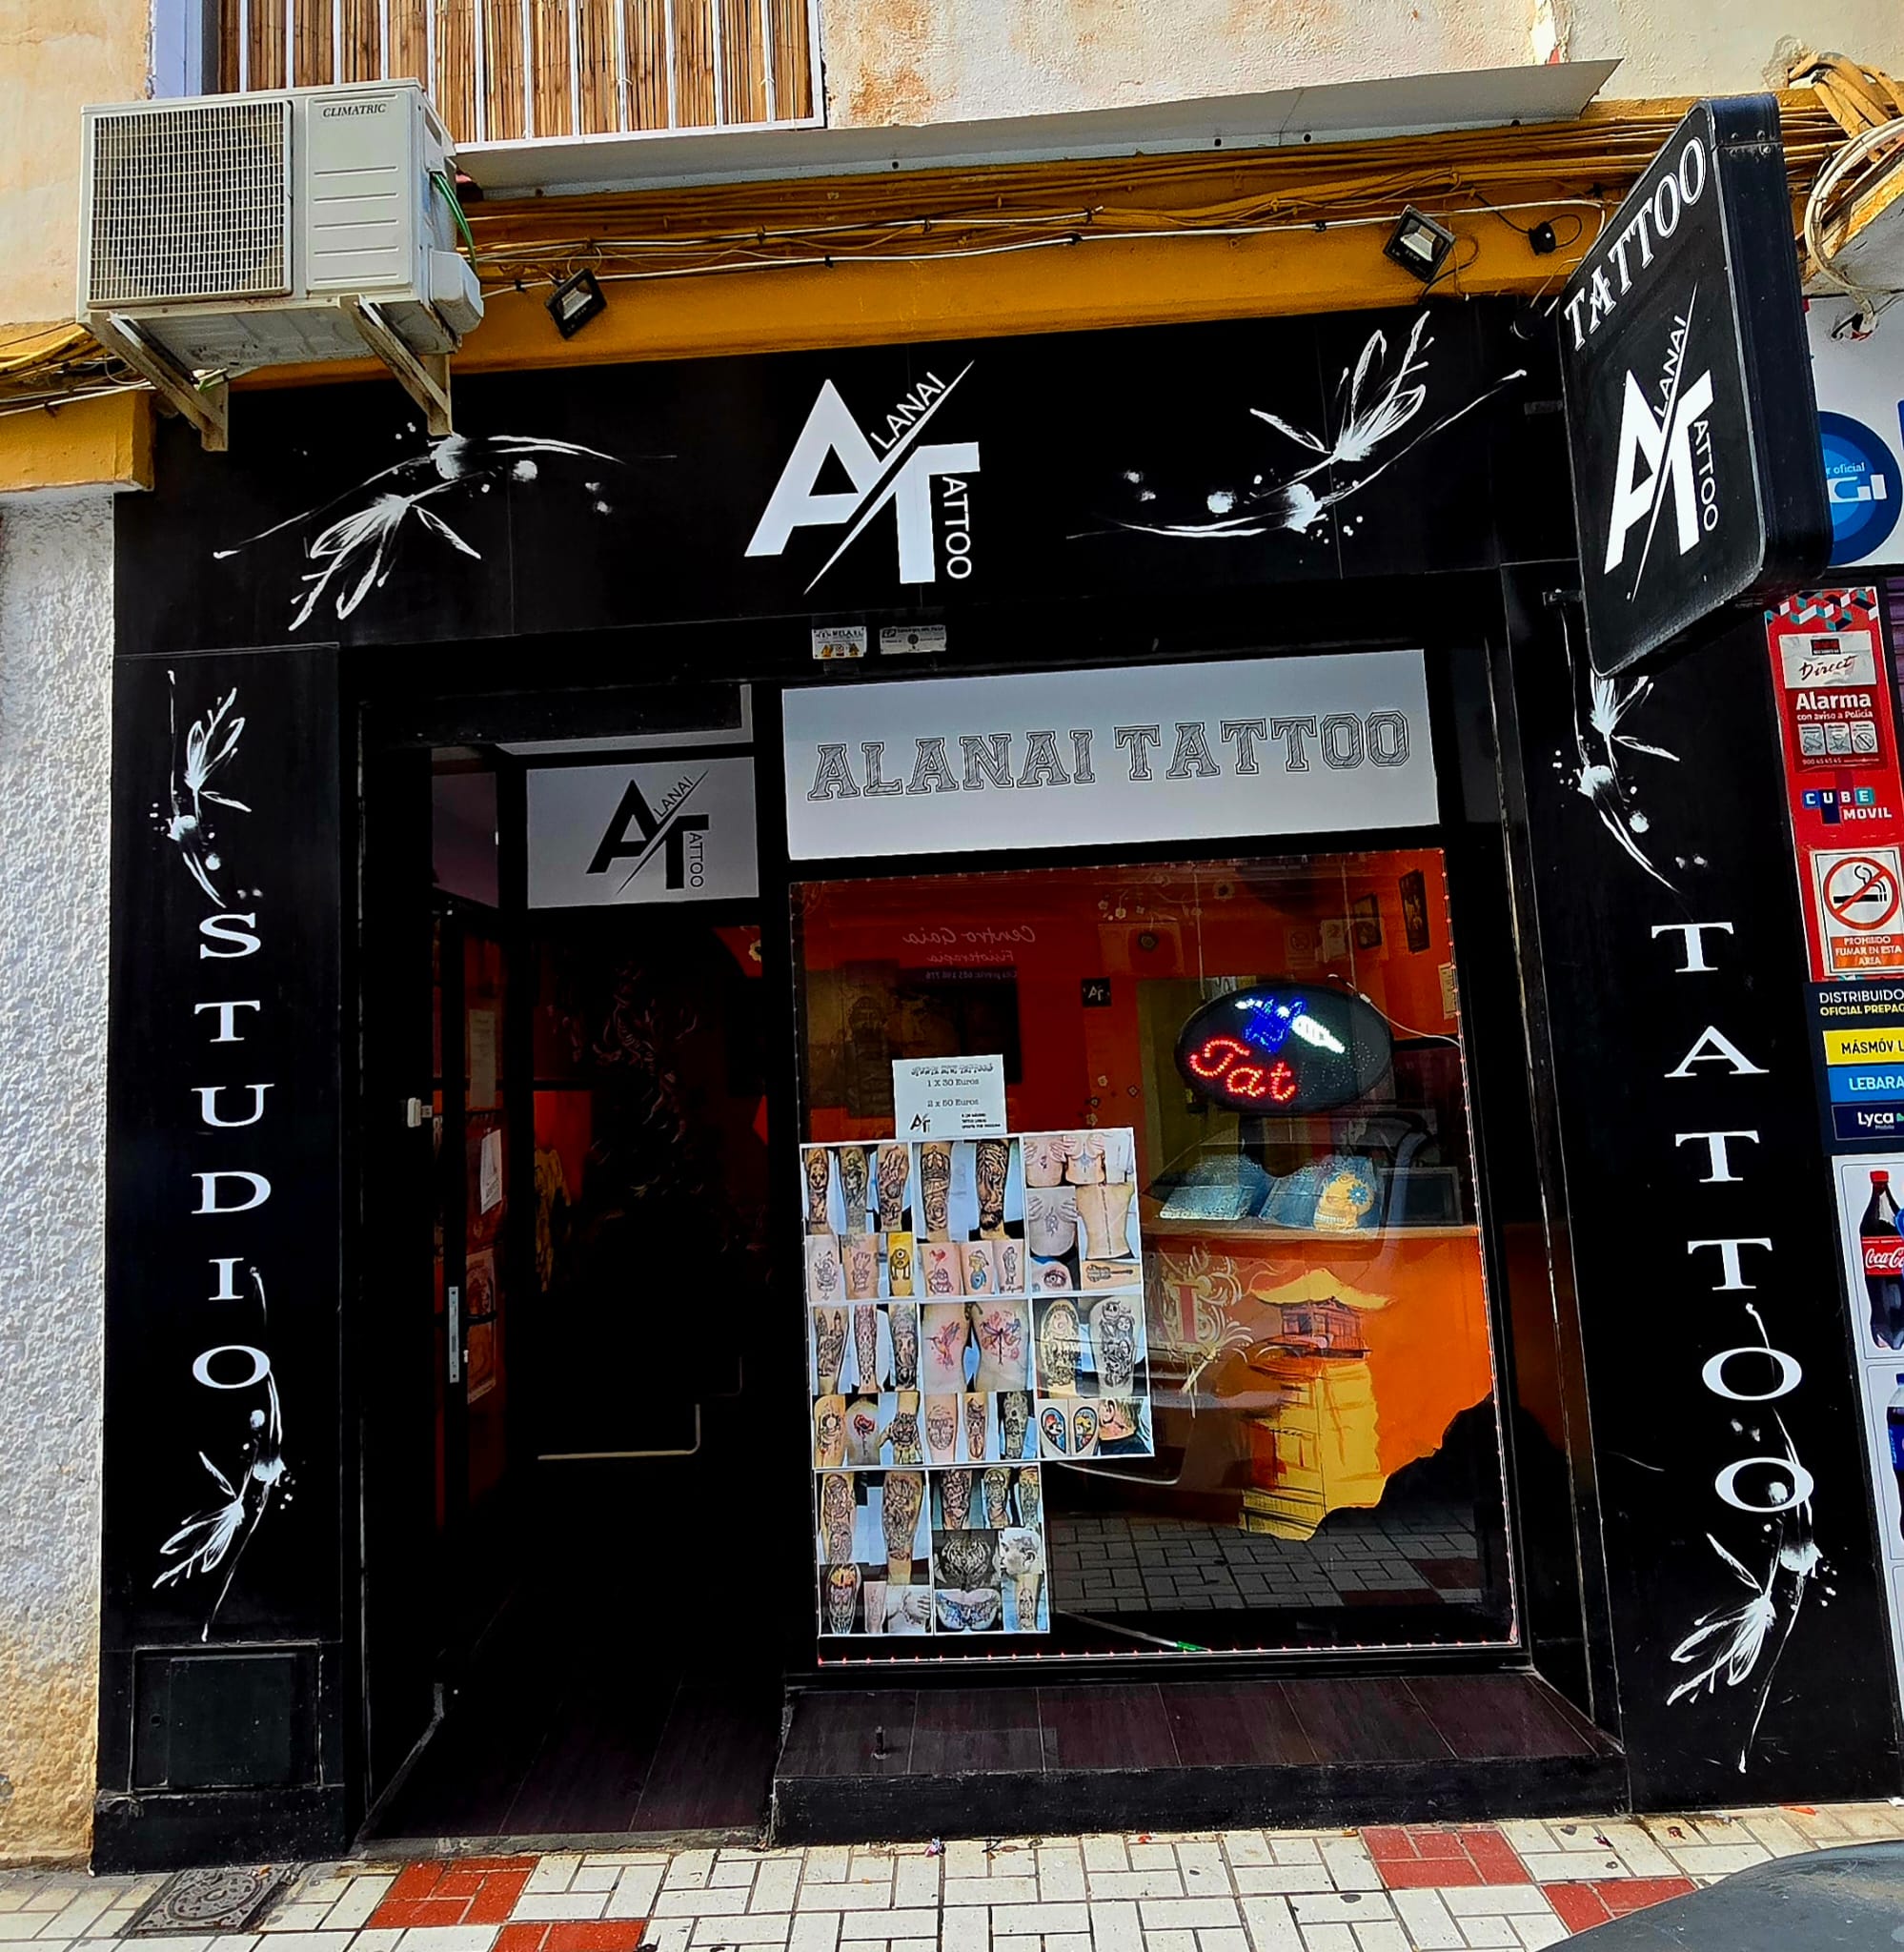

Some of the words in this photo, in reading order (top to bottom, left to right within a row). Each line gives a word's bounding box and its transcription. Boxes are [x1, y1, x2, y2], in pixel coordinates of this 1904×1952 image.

[322, 102, 387, 117] CLIMATRIC
[1564, 136, 1708, 352] TATTOO
[1833, 461, 1865, 475] oficial
[1799, 654, 1859, 681] Direct
[1795, 692, 1872, 710] Alarma
[1813, 712, 1835, 721] aviso
[806, 729, 1097, 802] ALANAI
[1115, 711, 1410, 781] TATTOO
[1805, 788, 1870, 805] CUBE
[1843, 806, 1893, 820] MOVIL
[1844, 936, 1891, 946] PROHIBIDO
[1835, 946, 1867, 956] FUMAR
[1881, 945, 1902, 954] ESTA
[1819, 988, 1904, 1004] DISTRIBUIDO
[1820, 1006, 1862, 1016] OFICIAL
[1849, 1075, 1904, 1091] LEBARA
[1857, 1111, 1894, 1128] Lyca
[192, 912, 274, 1389] STUDIO
[1651, 922, 1814, 1514] TATTOO
